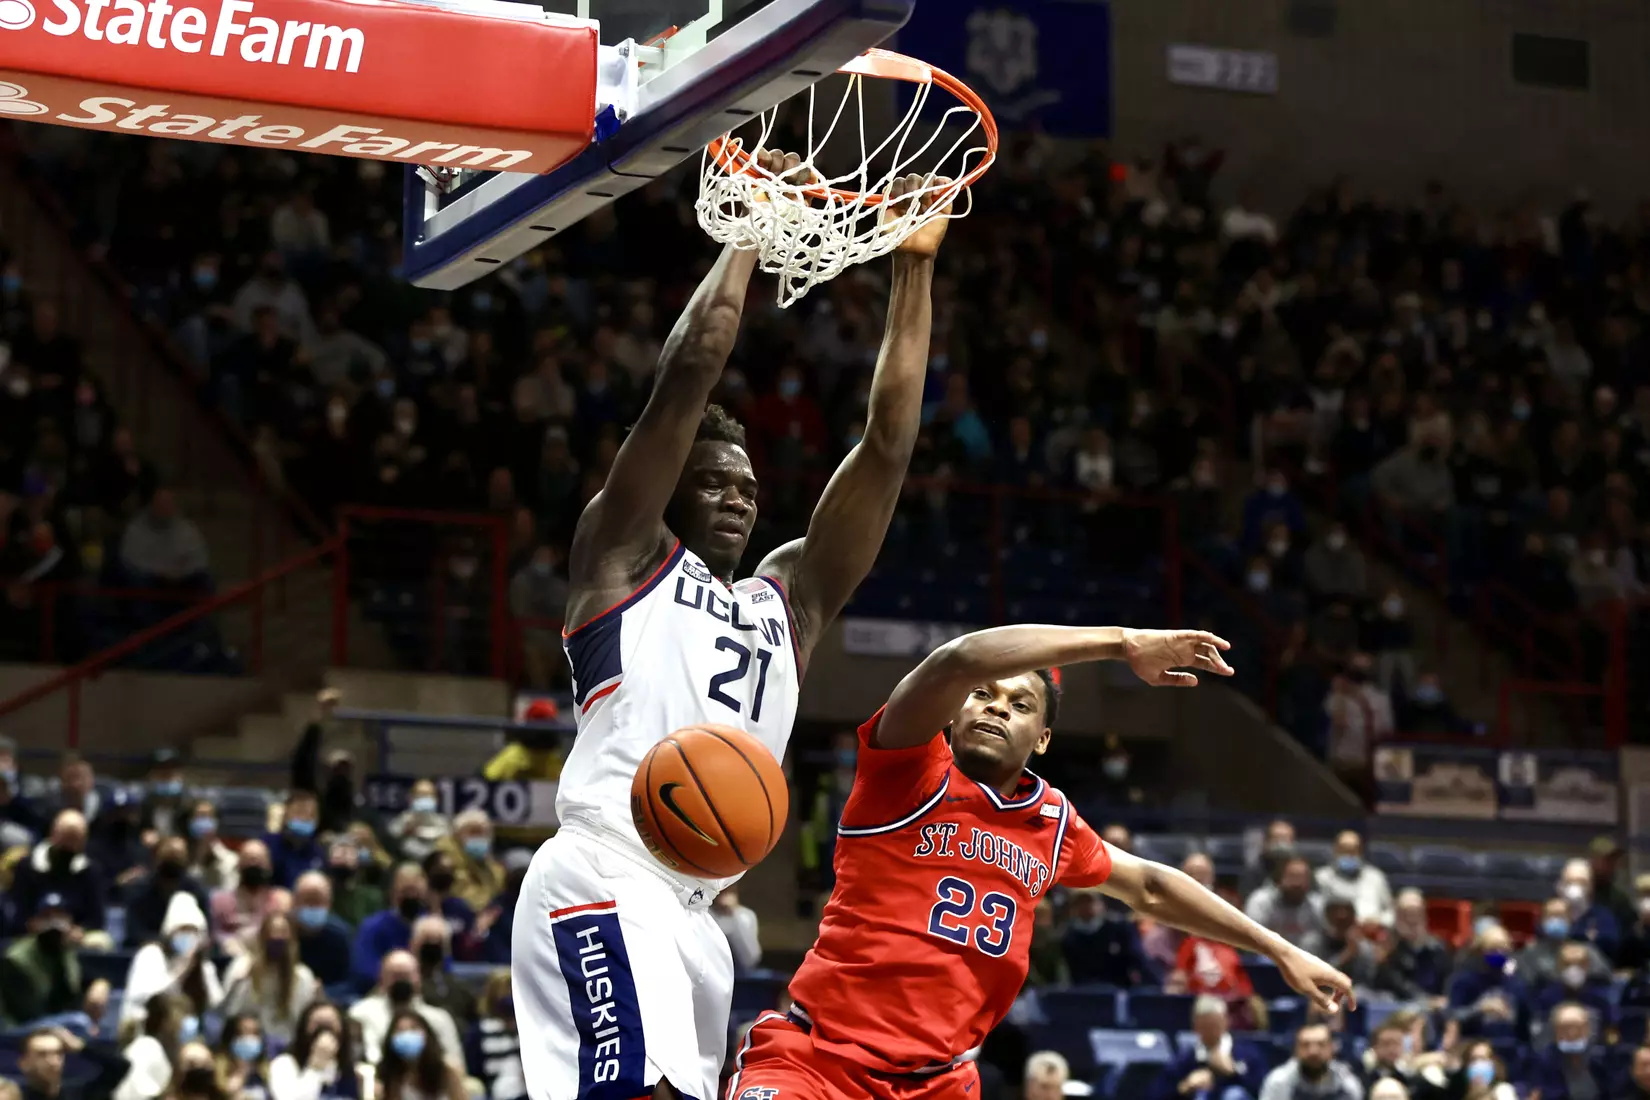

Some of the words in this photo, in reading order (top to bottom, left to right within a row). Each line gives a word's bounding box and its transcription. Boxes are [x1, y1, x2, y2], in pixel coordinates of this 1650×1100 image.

[707, 636, 773, 723] 21
[437, 777, 530, 824] 120
[913, 823, 959, 857] ST.
[959, 827, 1049, 897] JOHN'S
[927, 875, 1017, 958] 23
[575, 925, 621, 1084] HUSKIES
